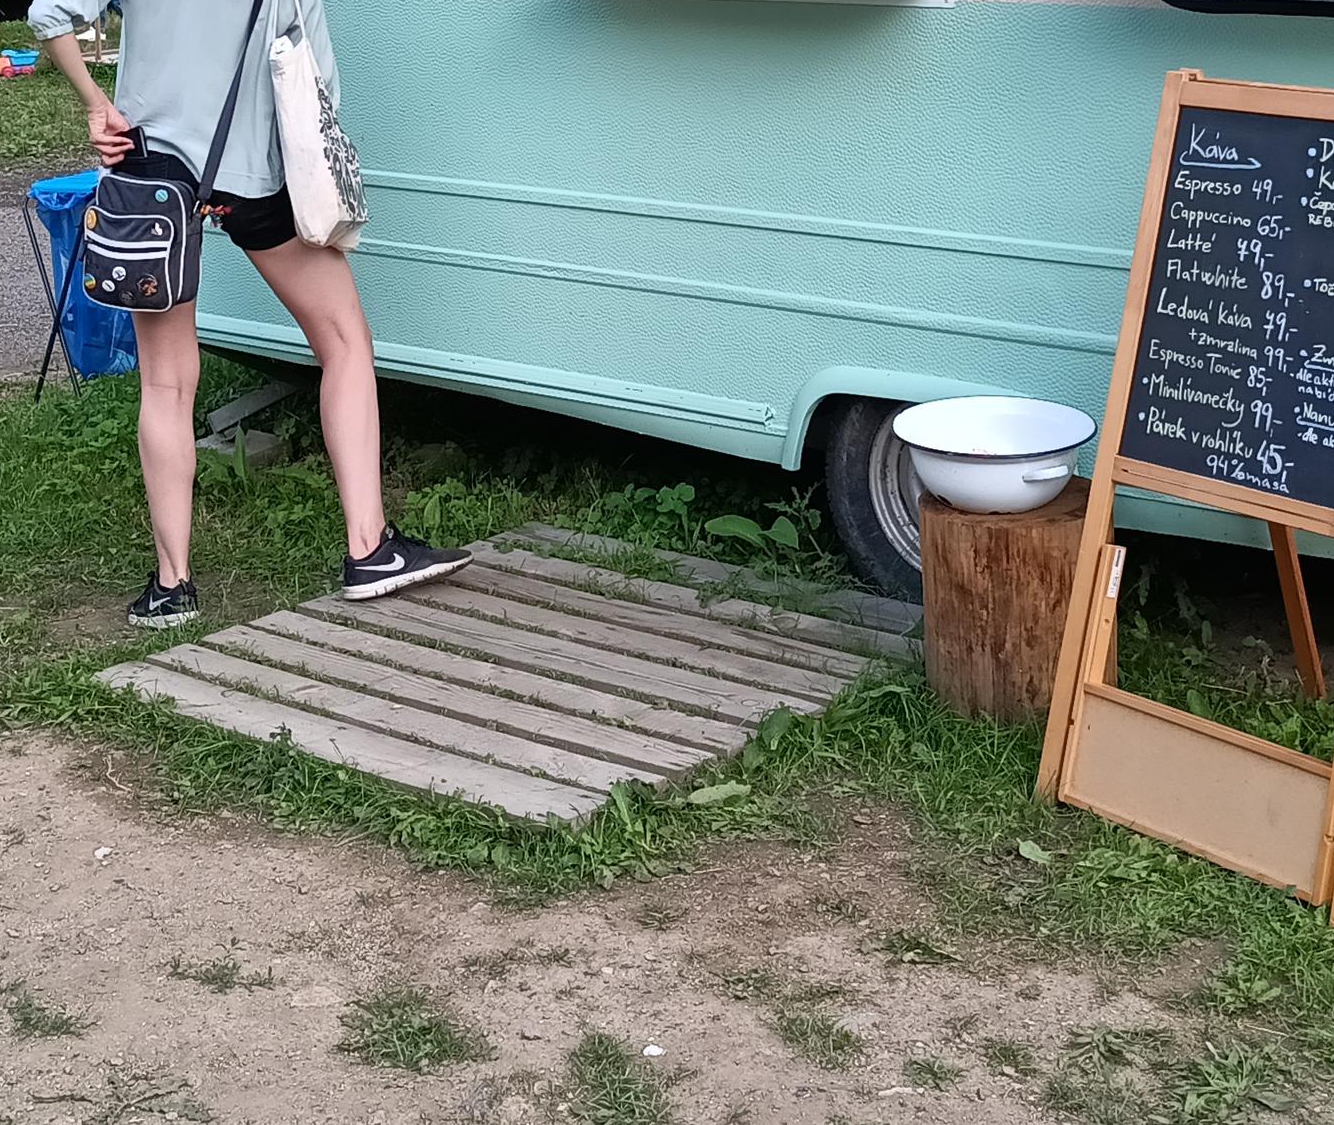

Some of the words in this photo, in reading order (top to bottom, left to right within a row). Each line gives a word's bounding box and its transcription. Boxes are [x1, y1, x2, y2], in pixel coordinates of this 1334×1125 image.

[1189, 123, 1239, 161] Káva
[1174, 170, 1242, 200] Espresso
[1170, 201, 1251, 228] Cappuccino
[1167, 228, 1216, 253] Latté
[1167, 259, 1248, 289] Flatwhite
[1157, 287, 1213, 324] Ledová
[1149, 339, 1204, 370] Espresso
[1206, 353, 1242, 379] Tonic
[1149, 372, 1245, 427] Minilívanečky
[1146, 406, 1187, 440] Párek
[1191, 431, 1200, 444] v
[1201, 428, 1253, 458] rohlíku
